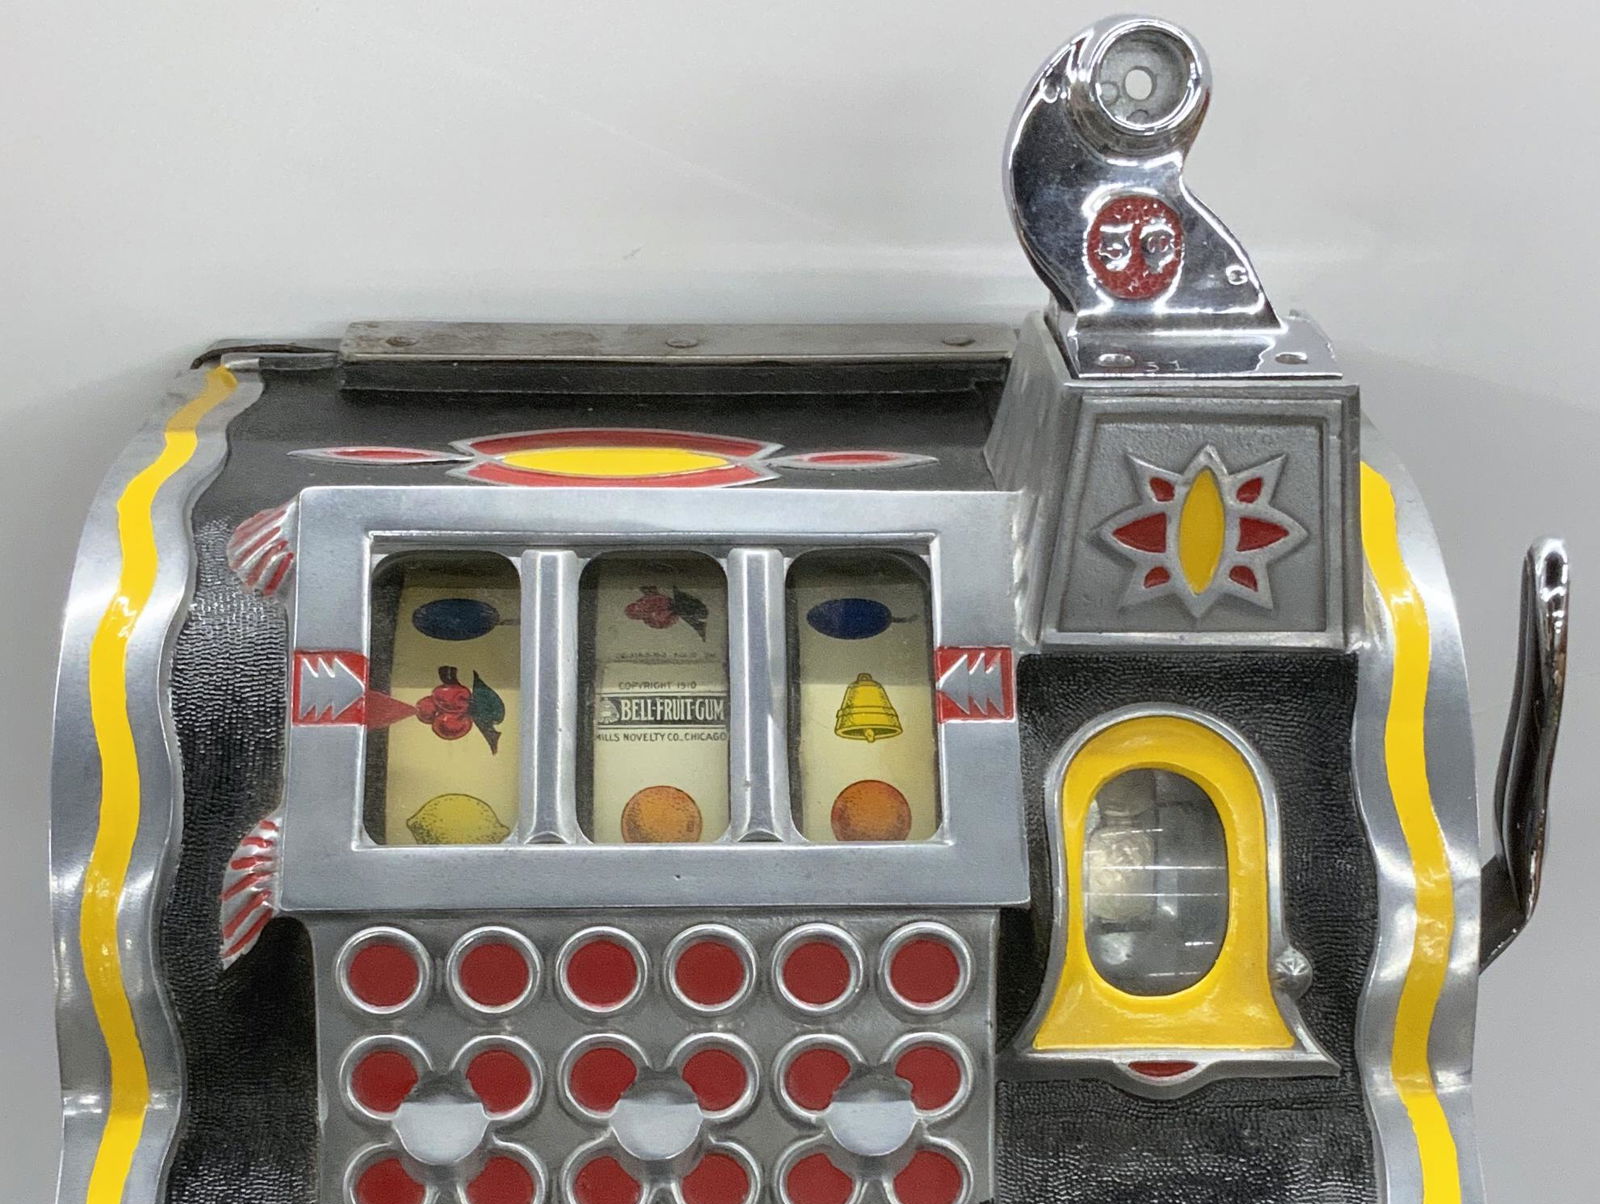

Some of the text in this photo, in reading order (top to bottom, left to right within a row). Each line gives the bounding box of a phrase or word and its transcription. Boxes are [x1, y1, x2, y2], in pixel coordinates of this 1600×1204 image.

[618, 681, 698, 690] COPYRIGHT 1910
[623, 732, 665, 742] NOVELTY
[684, 732, 727, 742] CHICAGO
